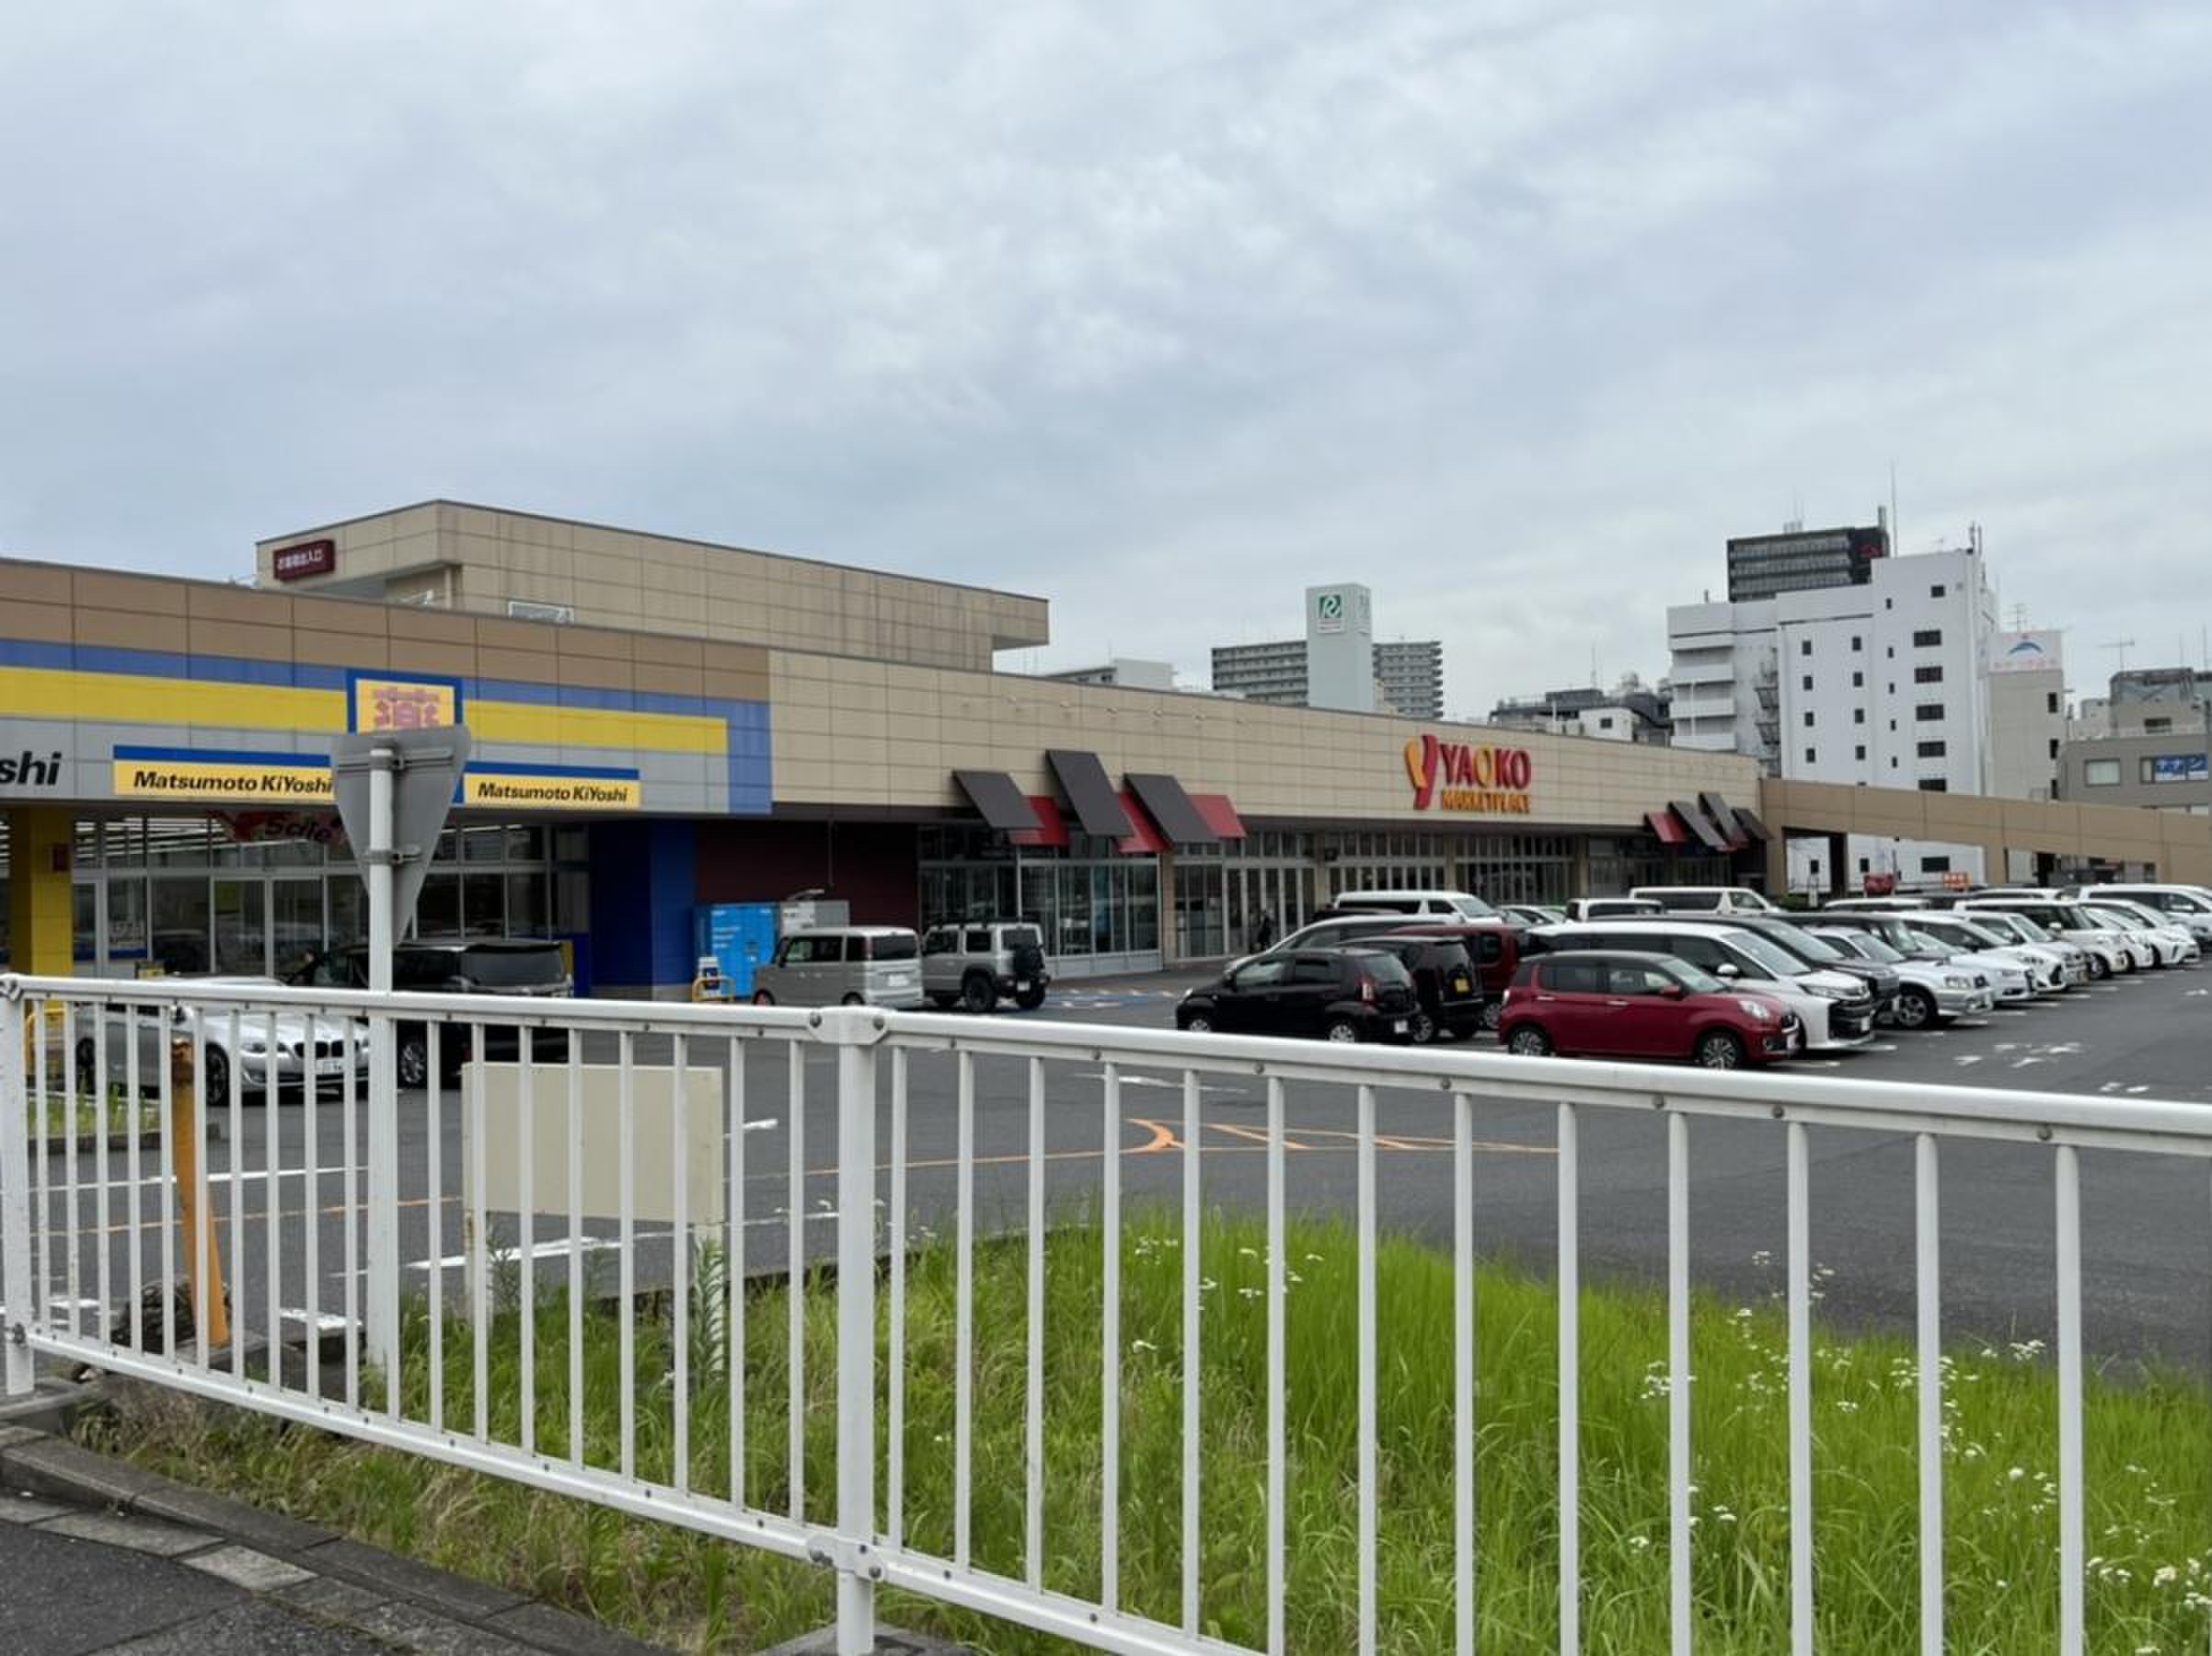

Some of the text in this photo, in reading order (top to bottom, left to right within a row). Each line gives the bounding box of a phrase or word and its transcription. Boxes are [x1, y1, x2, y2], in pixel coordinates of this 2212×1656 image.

[0, 751, 62, 786] shi
[1440, 742, 1532, 790] YAOKO
[133, 771, 333, 794] Matsumoto KiYoshi
[478, 782, 628, 802] Matsumoto KiYoshi
